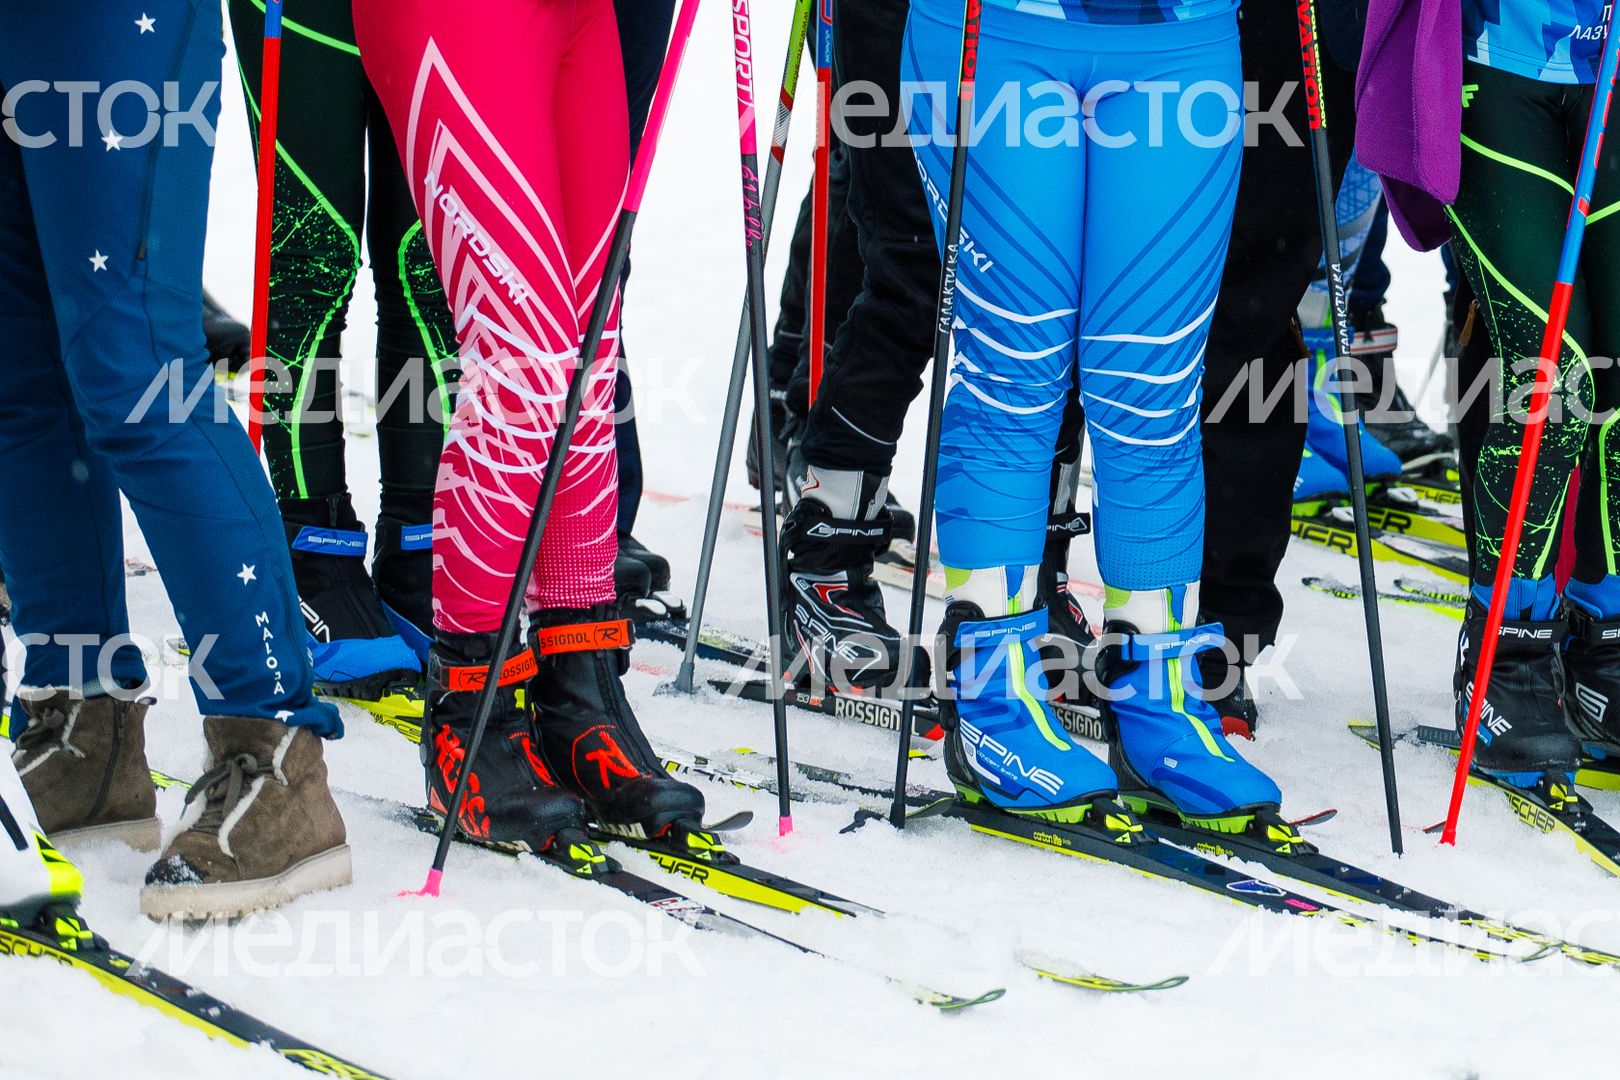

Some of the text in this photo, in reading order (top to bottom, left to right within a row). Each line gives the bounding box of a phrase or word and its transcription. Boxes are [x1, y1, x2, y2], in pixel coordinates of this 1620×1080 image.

[423, 168, 531, 307] NORDSKI
[307, 535, 365, 548] SPINE
[834, 697, 919, 736] ROSSIGNL
[959, 717, 1065, 796] SPINE
